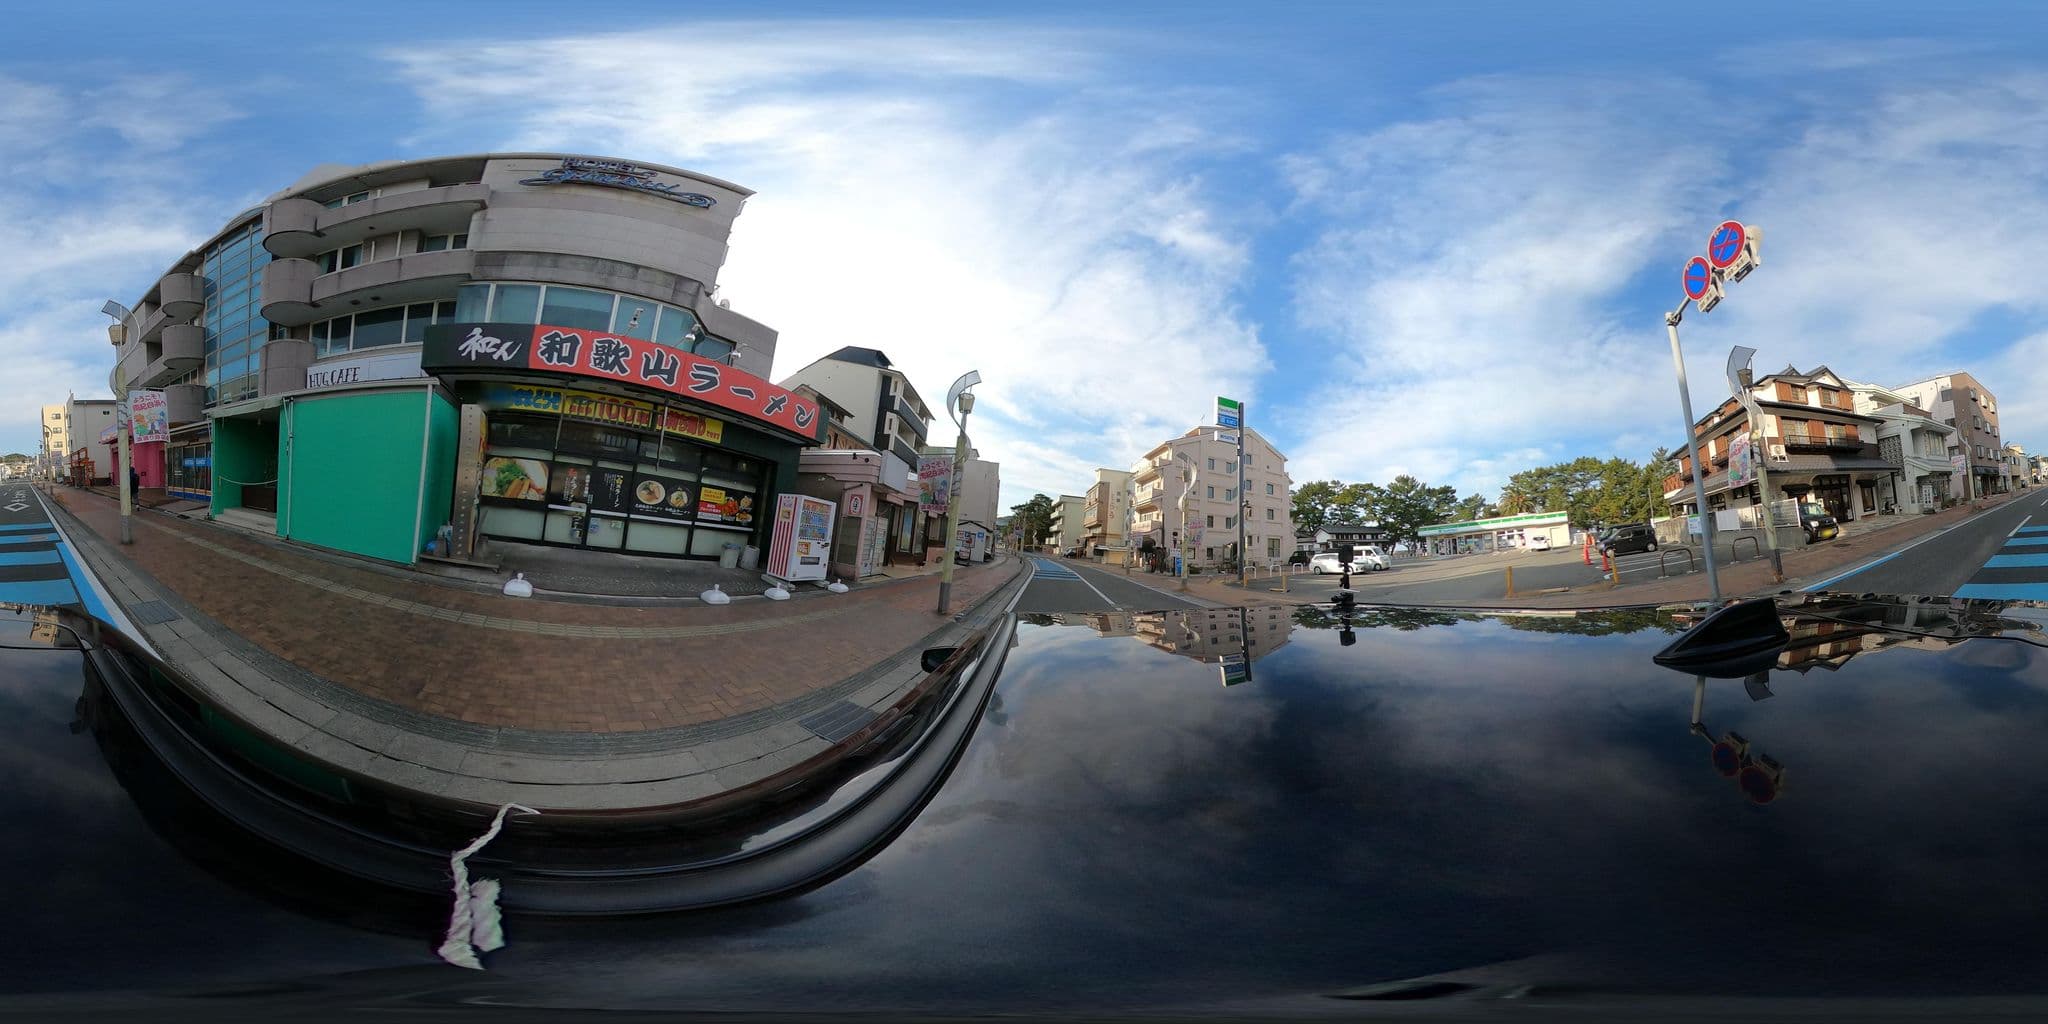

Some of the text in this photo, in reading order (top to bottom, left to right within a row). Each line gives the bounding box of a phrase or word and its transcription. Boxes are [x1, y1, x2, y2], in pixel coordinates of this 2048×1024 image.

[309, 366, 361, 388] HUG CAFE
[537, 330, 815, 430] 和歌山ラーメン
